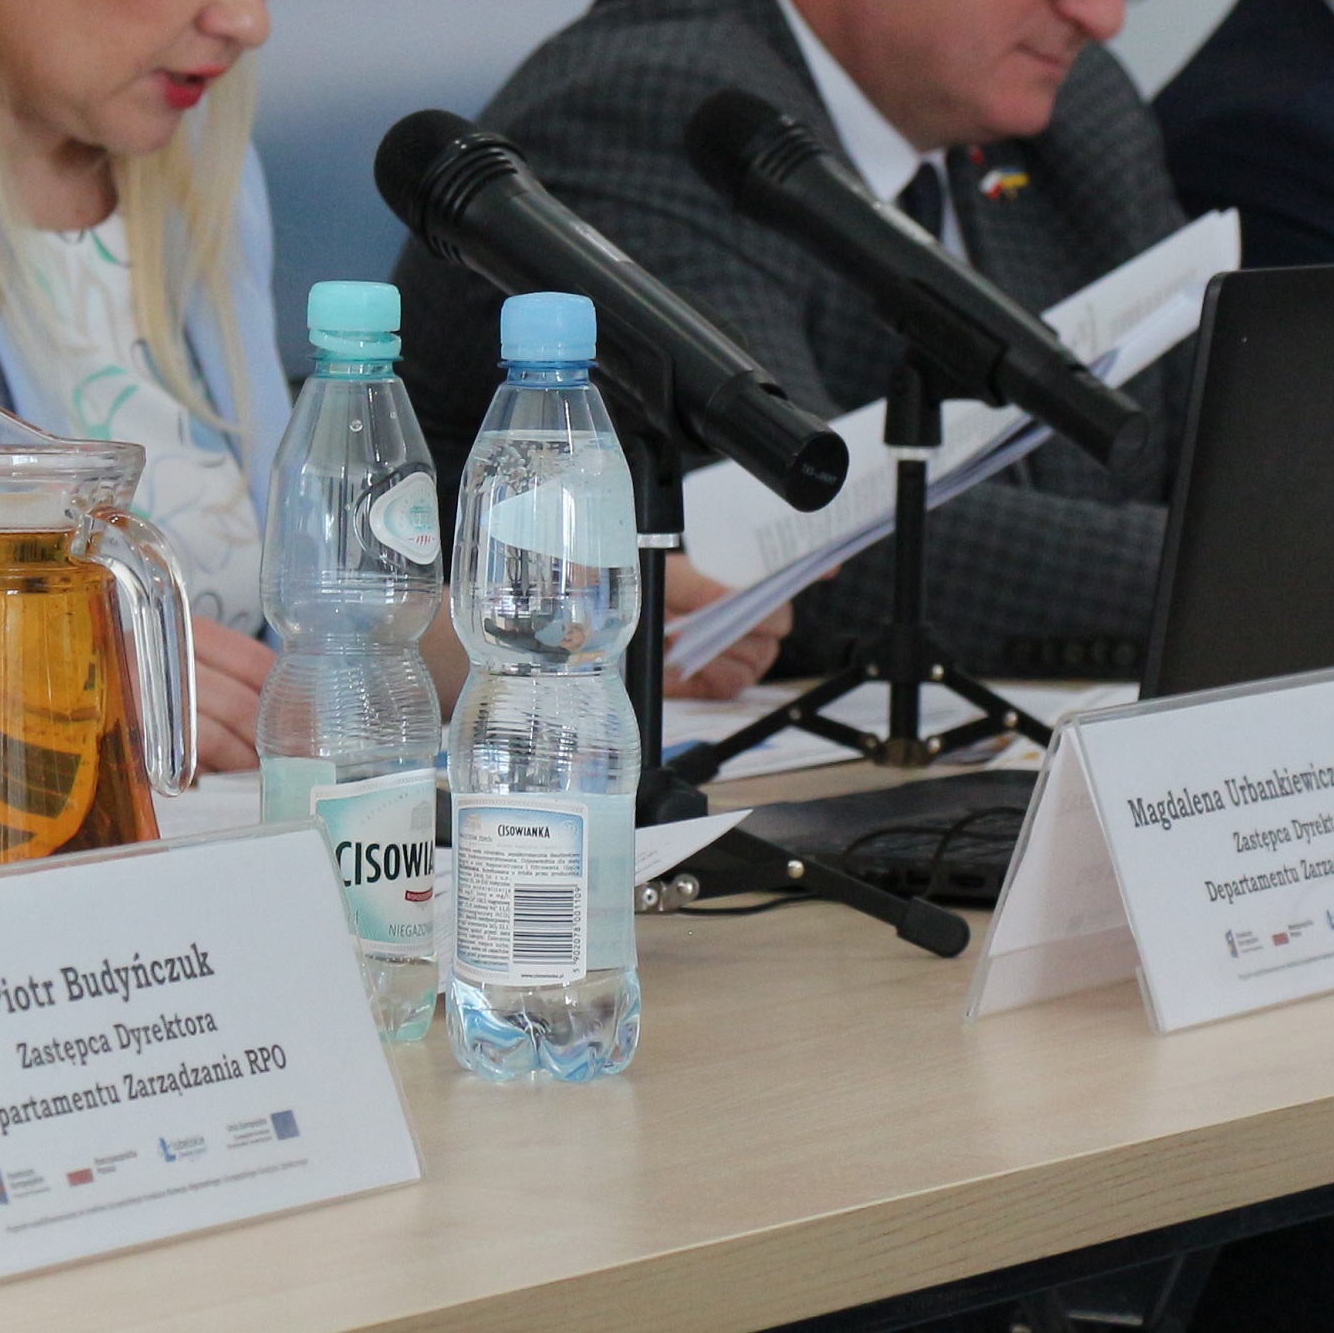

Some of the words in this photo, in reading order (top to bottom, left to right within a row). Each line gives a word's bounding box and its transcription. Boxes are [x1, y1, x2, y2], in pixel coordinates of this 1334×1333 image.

[1127, 787, 1225, 830] Magdalena
[498, 824, 550, 839] CISOWIANKA
[1233, 826, 1292, 854] Zastępca
[1205, 865, 1299, 904] Departamentu
[60, 942, 215, 1003] Budyńczuk
[16, 1032, 113, 1069] Zastępca
[113, 1008, 218, 1054] Dyrektora
[123, 1057, 244, 1102] Zarządzania
[244, 1043, 287, 1074] RPO
